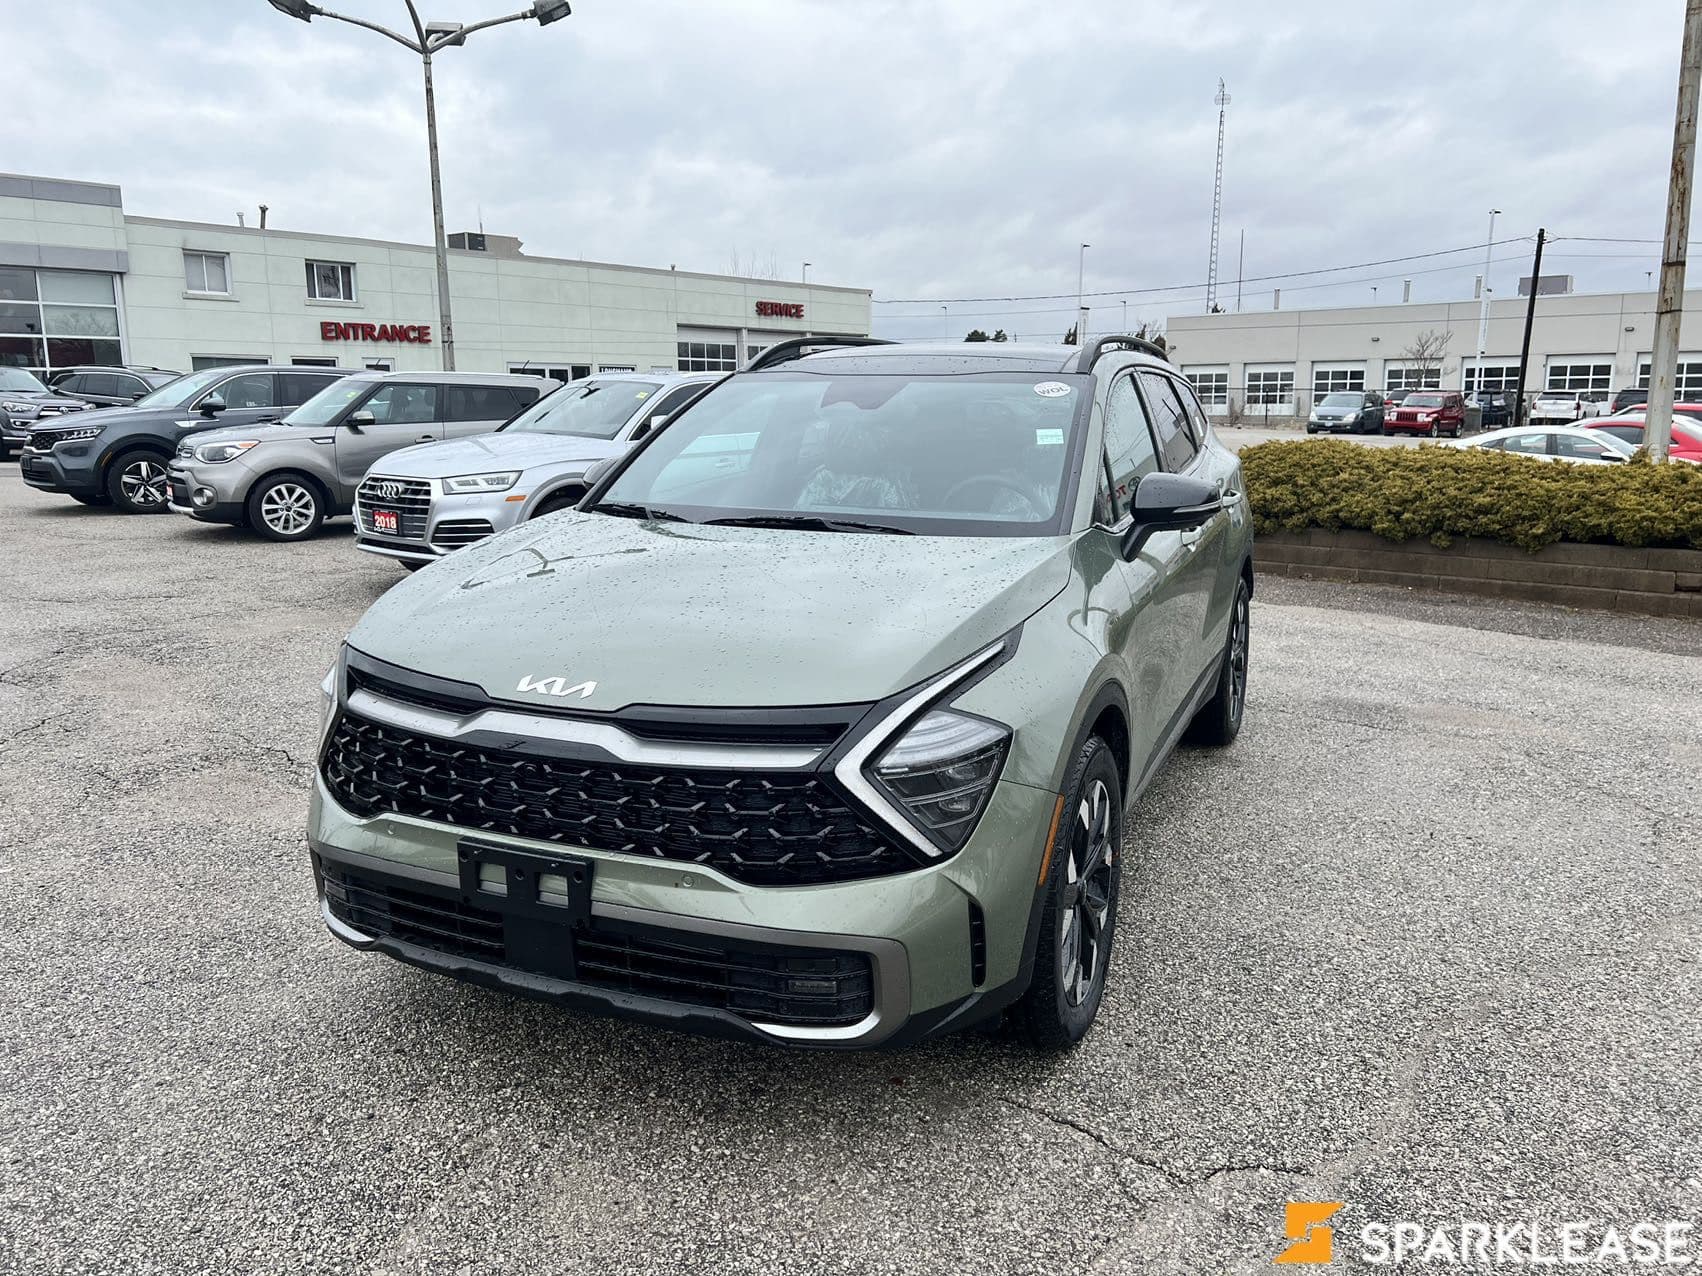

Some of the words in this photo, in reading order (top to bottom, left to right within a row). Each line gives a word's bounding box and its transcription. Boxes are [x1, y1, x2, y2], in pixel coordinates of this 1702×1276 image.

[755, 301, 804, 319] SERVICE
[320, 321, 432, 344] ENTRANCE
[374, 515, 397, 529] 2018
